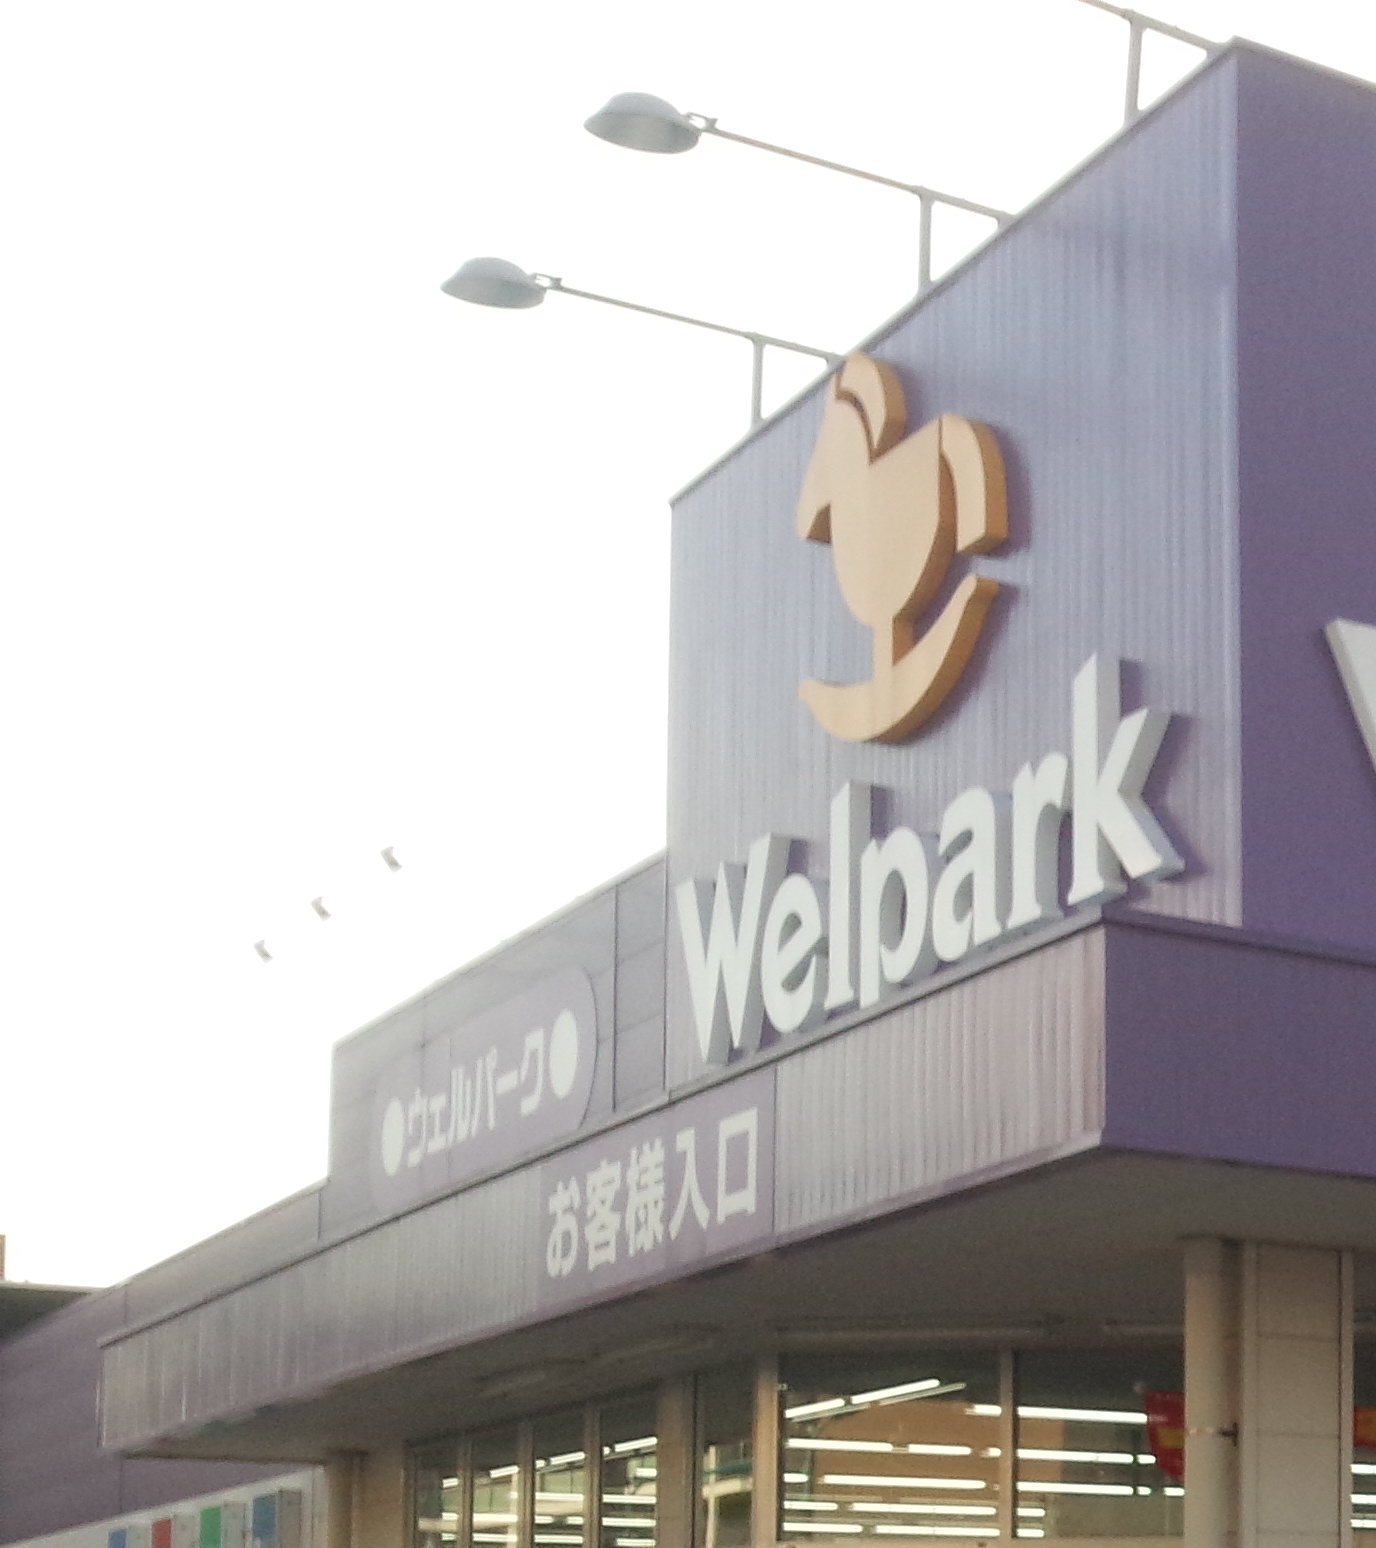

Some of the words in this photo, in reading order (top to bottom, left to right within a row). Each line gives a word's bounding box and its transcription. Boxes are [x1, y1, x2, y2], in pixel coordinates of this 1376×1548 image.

[675, 652, 1183, 1066] Welpark
[406, 1025, 545, 1169] ウェルパーク
[545, 1106, 759, 1280] お客様入口
